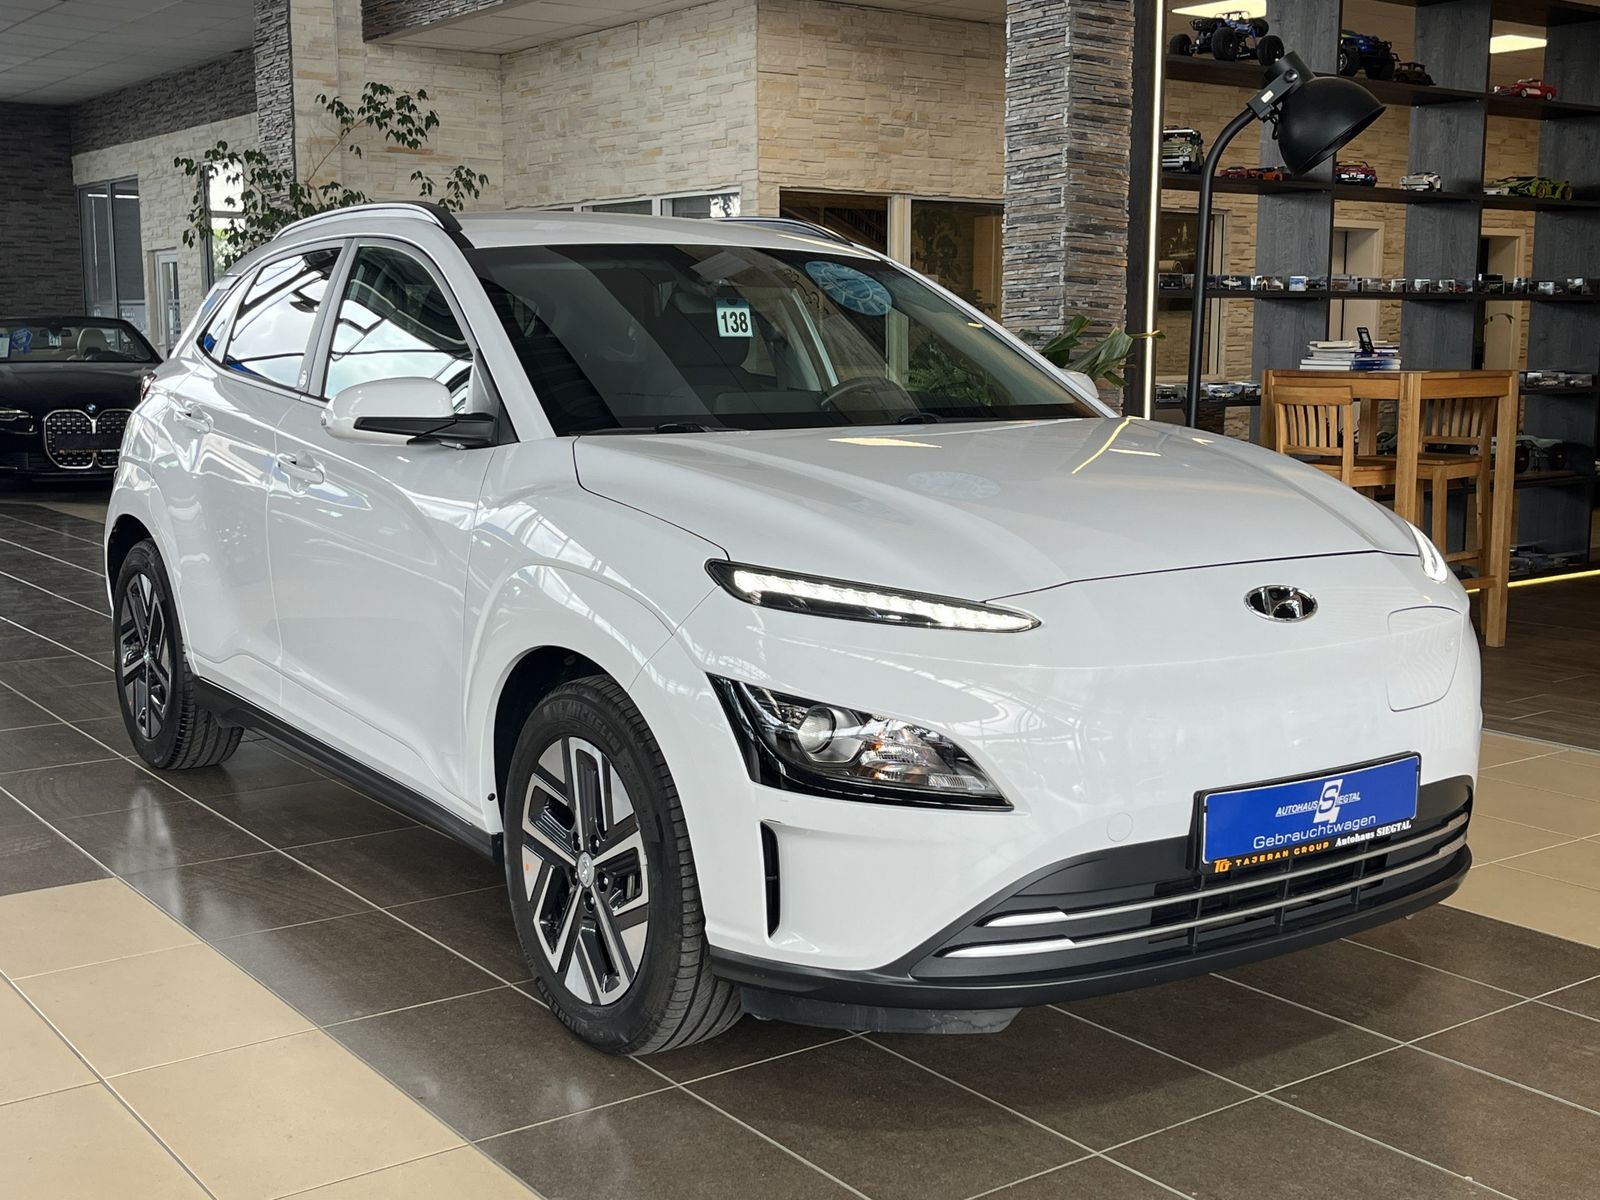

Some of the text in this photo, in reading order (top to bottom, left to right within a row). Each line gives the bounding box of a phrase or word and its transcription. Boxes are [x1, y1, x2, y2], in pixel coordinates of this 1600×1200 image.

[721, 311, 748, 333] 138
[566, 700, 621, 753] MICHELIN
[1275, 800, 1319, 817] AUTOHAUS
[1253, 815, 1377, 849] Gebrauchtwagen
[1293, 841, 1330, 856] GROUP
[1335, 831, 1375, 848] Autohaus
[1376, 820, 1412, 837] SIEGTAL
